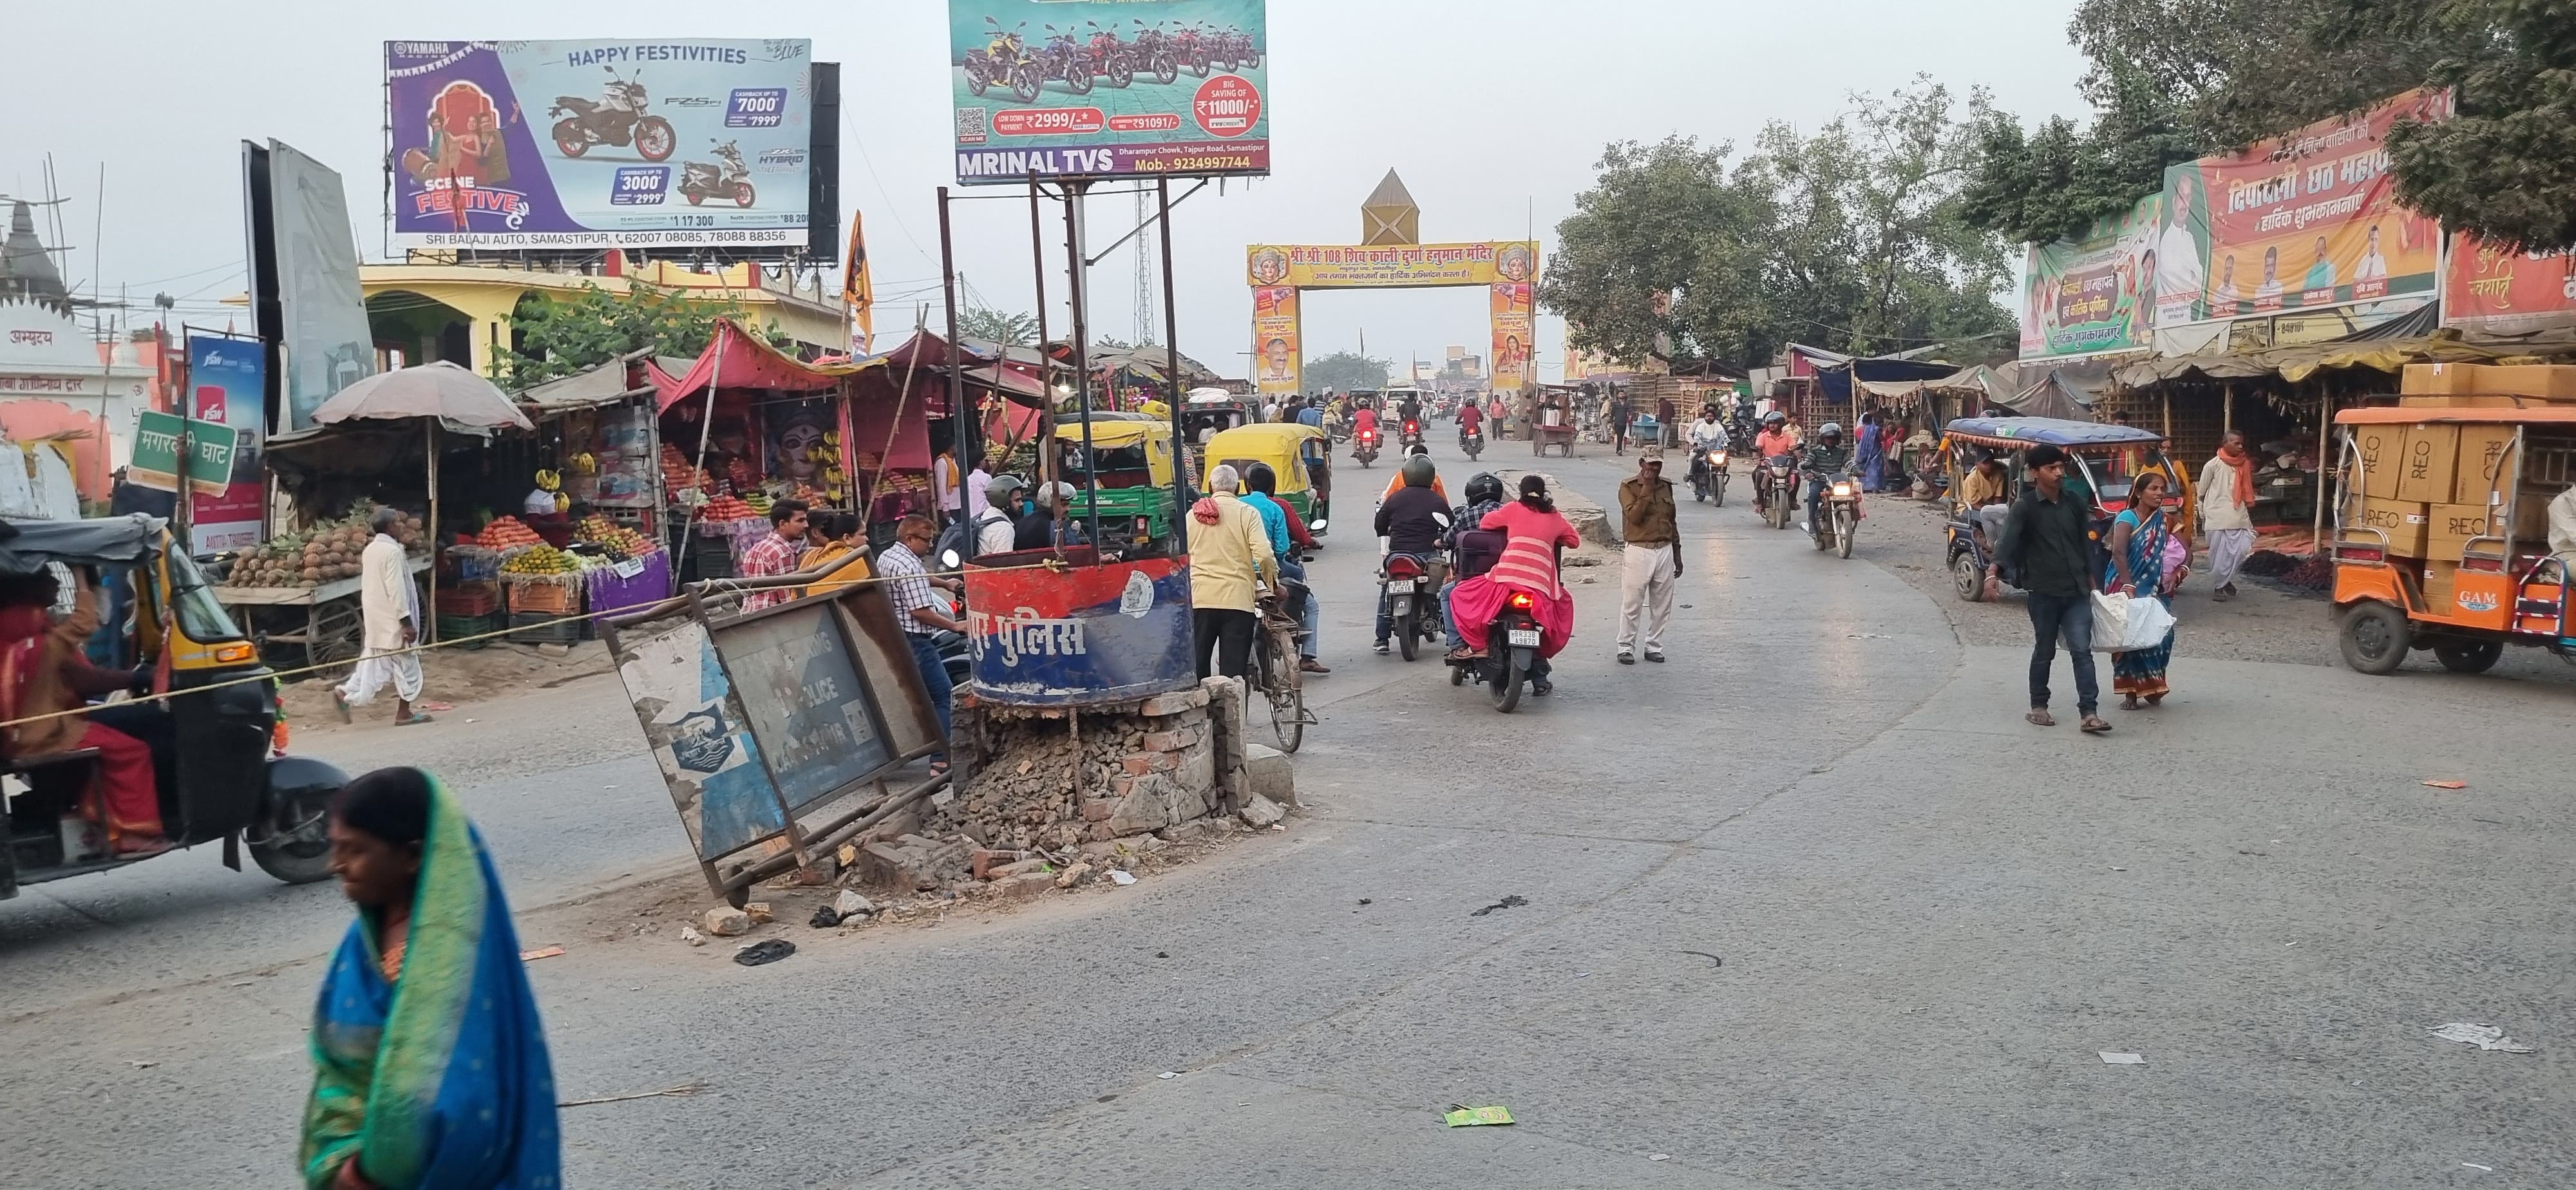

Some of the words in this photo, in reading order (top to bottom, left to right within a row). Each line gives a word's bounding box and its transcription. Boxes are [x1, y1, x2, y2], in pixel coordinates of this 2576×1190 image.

[407, 42, 450, 55] YAMAHA
[568, 46, 630, 67] HAPPY
[635, 45, 746, 64] FESTIVITIES
[773, 44, 804, 61] BLUE
[1119, 147, 1157, 156] Dharampur
[1158, 146, 1184, 155] Chowk,
[1184, 145, 1206, 155] Tajpur
[1206, 144, 1226, 153] Road,
[1226, 143, 1265, 153] Samastipur
[759, 155, 804, 166] HYBRID
[959, 151, 1060, 176] MRINAL
[1063, 149, 1113, 173] TVS
[1135, 158, 1171, 171] Mob.-
[1173, 156, 1251, 170] 9234997744
[425, 176, 475, 191] SCENE
[2307, 160, 2338, 194] छठ
[2261, 205, 2293, 232] हार्दिक
[426, 234, 446, 245] SRI
[449, 234, 490, 245] BALAJI
[493, 234, 528, 246] AUTO,
[531, 233, 613, 245] SAMASTIPUR,
[625, 232, 661, 243] 62007
[665, 232, 706, 243] 08085,
[709, 232, 746, 242] 78088
[749, 231, 786, 241] 88356
[1290, 247, 1305, 264] श्री
[1307, 247, 1321, 264] श्री
[1324, 249, 1341, 263] 108
[1344, 247, 1367, 263] शिव
[1369, 247, 1400, 263] काली
[1401, 246, 1423, 267] दुर्गा
[1425, 248, 1464, 266] हनुमान
[1465, 244, 1494, 260] मंदिर
[1390, 270, 1410, 280] हार्दिक
[1411, 270, 1441, 279] अभिनंदन
[202, 442, 229, 464] घाट
[2363, 435, 2381, 474] REO
[2411, 440, 2430, 480] REO
[2366, 509, 2400, 529] REO
[2448, 517, 2486, 535] REO
[2459, 590, 2497, 603] GAM
[995, 607, 1086, 668] पुलिस
